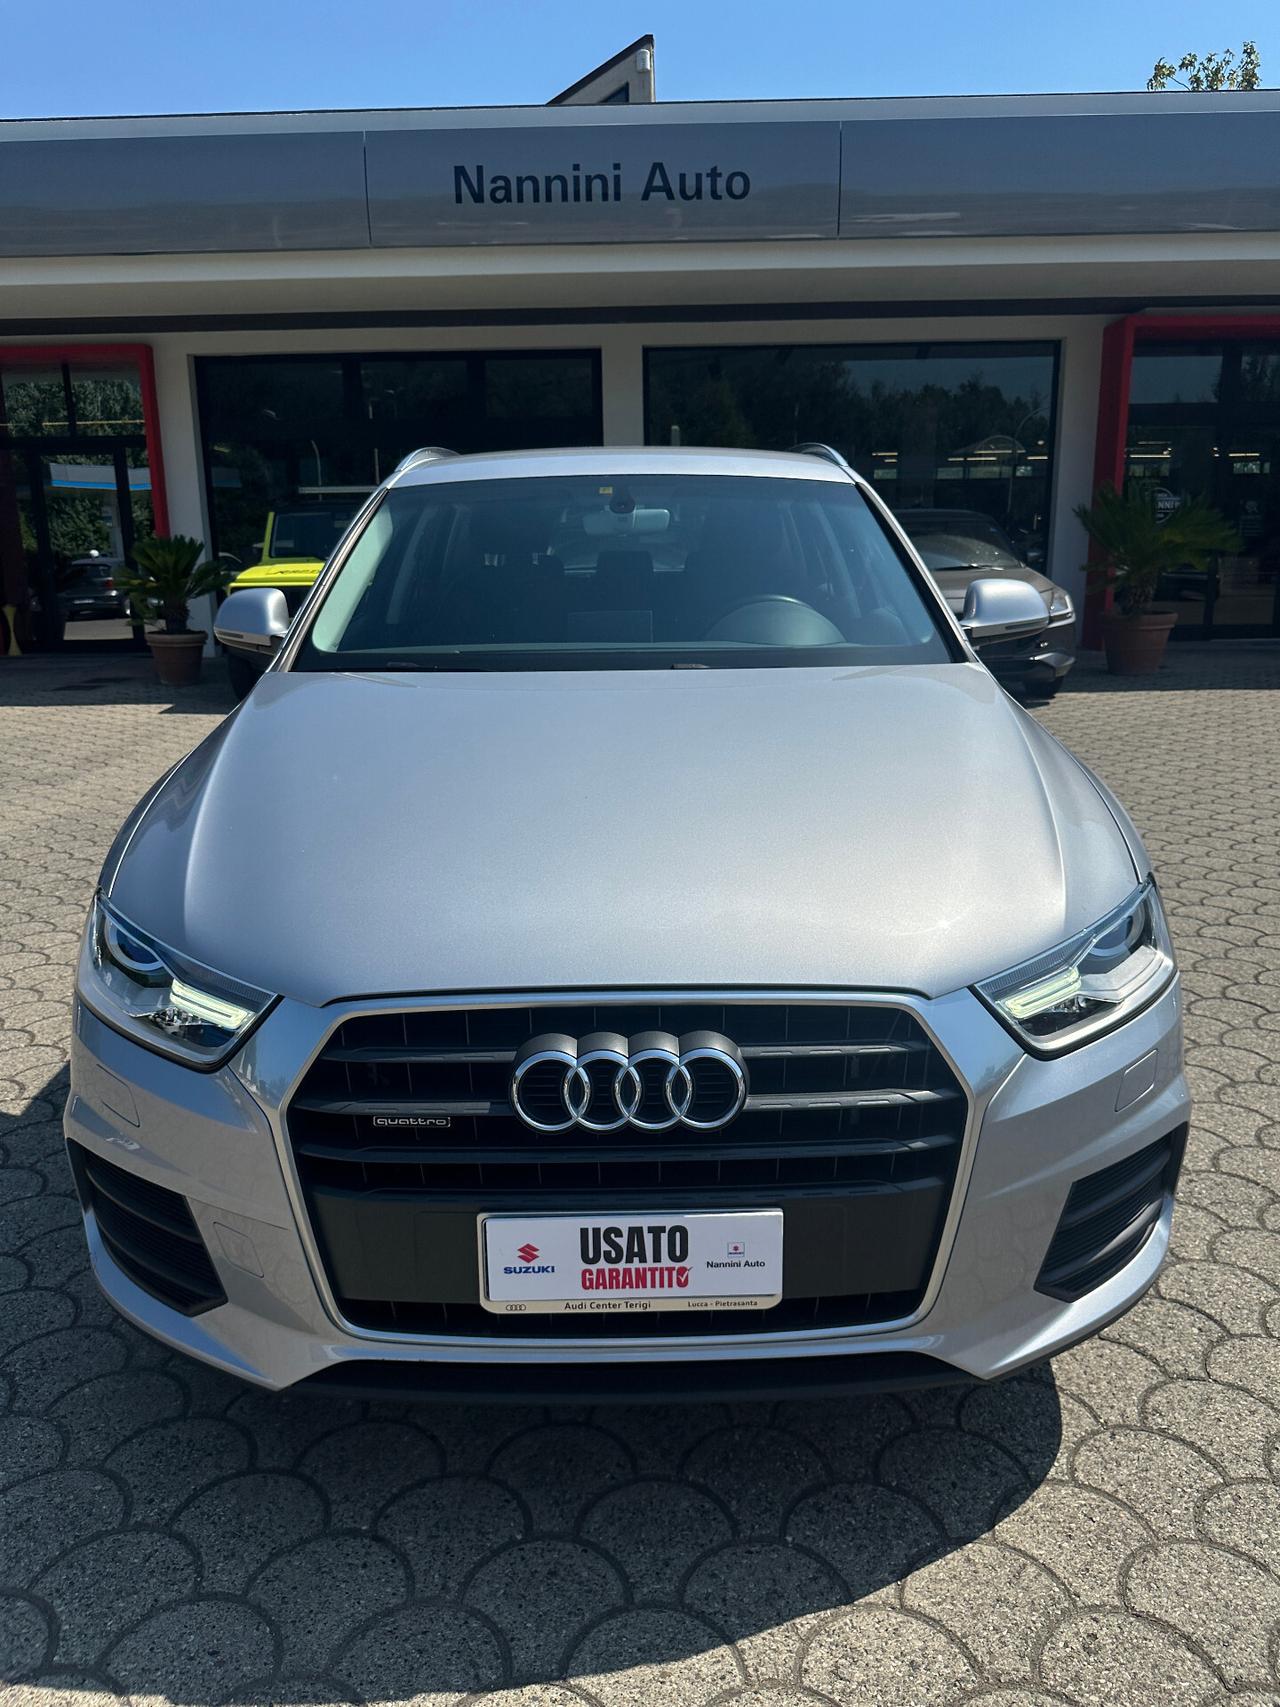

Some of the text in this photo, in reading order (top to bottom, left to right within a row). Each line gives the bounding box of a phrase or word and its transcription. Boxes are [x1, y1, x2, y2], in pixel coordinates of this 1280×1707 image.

[453, 161, 751, 204] Nannini Auto
[377, 1118, 447, 1126] quattro
[579, 1224, 689, 1265] USATO
[706, 1259, 766, 1269] Nannini Auto
[503, 1265, 555, 1275] SUZUKI
[581, 1265, 690, 1291] GARANTITO
[564, 1300, 651, 1311] Audi Center Terigi
[687, 1300, 709, 1308] Lucca
[714, 1299, 758, 1308] Pietrasanta
